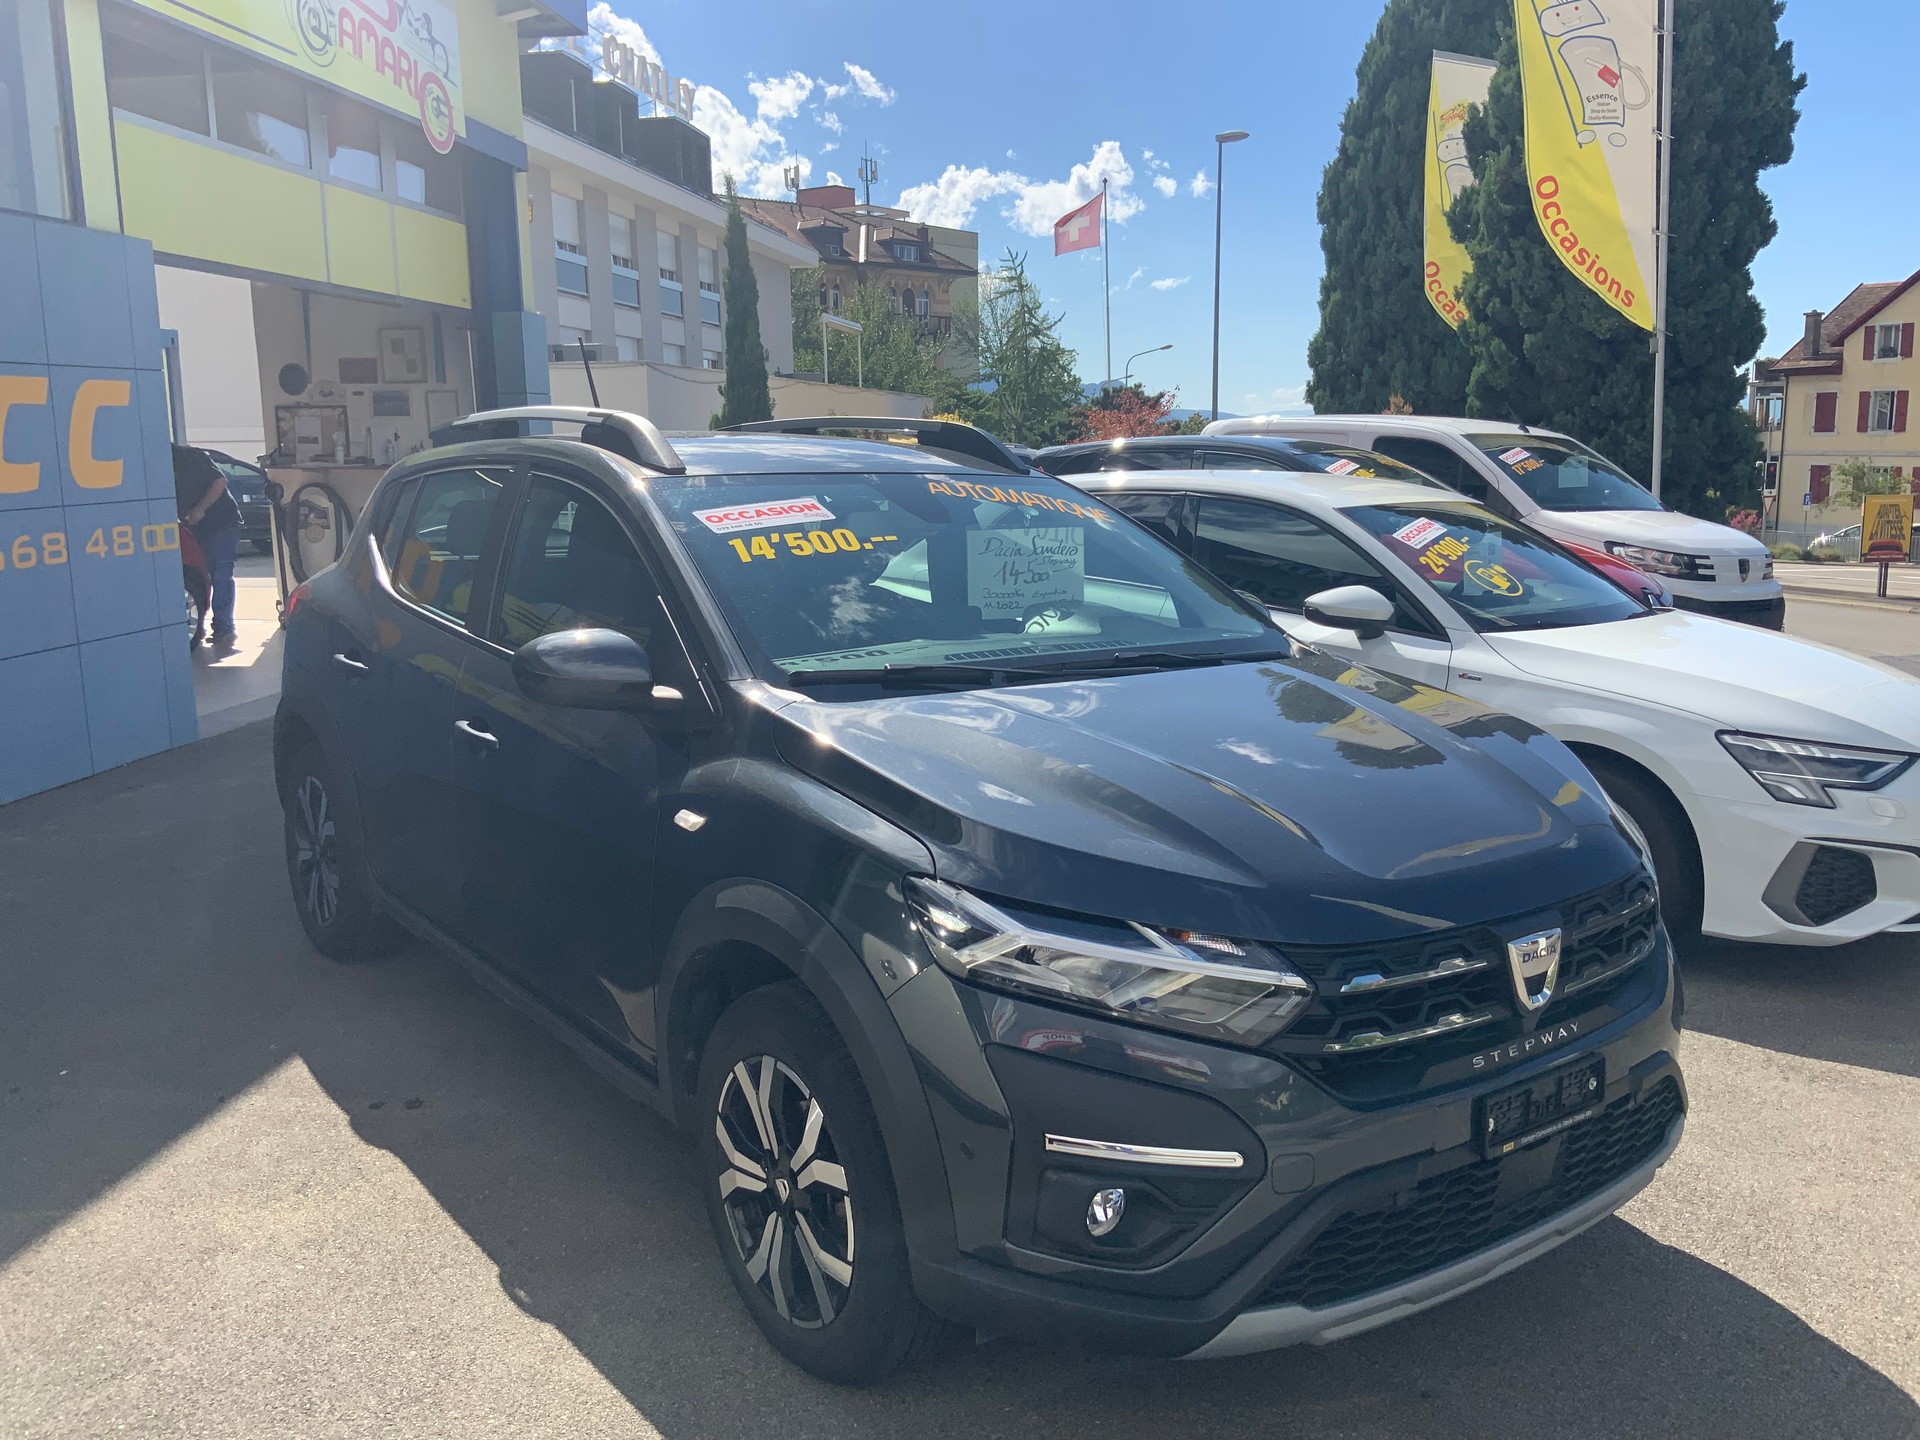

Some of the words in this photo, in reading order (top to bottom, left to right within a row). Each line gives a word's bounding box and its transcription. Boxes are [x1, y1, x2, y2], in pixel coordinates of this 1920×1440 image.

[602, 33, 696, 121] CHAILLY
[1586, 93, 1618, 103] Essence
[1536, 175, 1635, 308] Occasions
[1425, 261, 1466, 324] Occas
[705, 503, 821, 524] OCCASION
[928, 482, 1116, 523] AUTOMATIQUE
[978, 537, 1024, 557] Dacia
[1028, 535, 1078, 557] Sandero
[1401, 520, 1435, 542] OCCASION
[0, 532, 68, 571] 68
[1522, 946, 1556, 964] DACIA
[1472, 1021, 1579, 1069] STEPWAY
